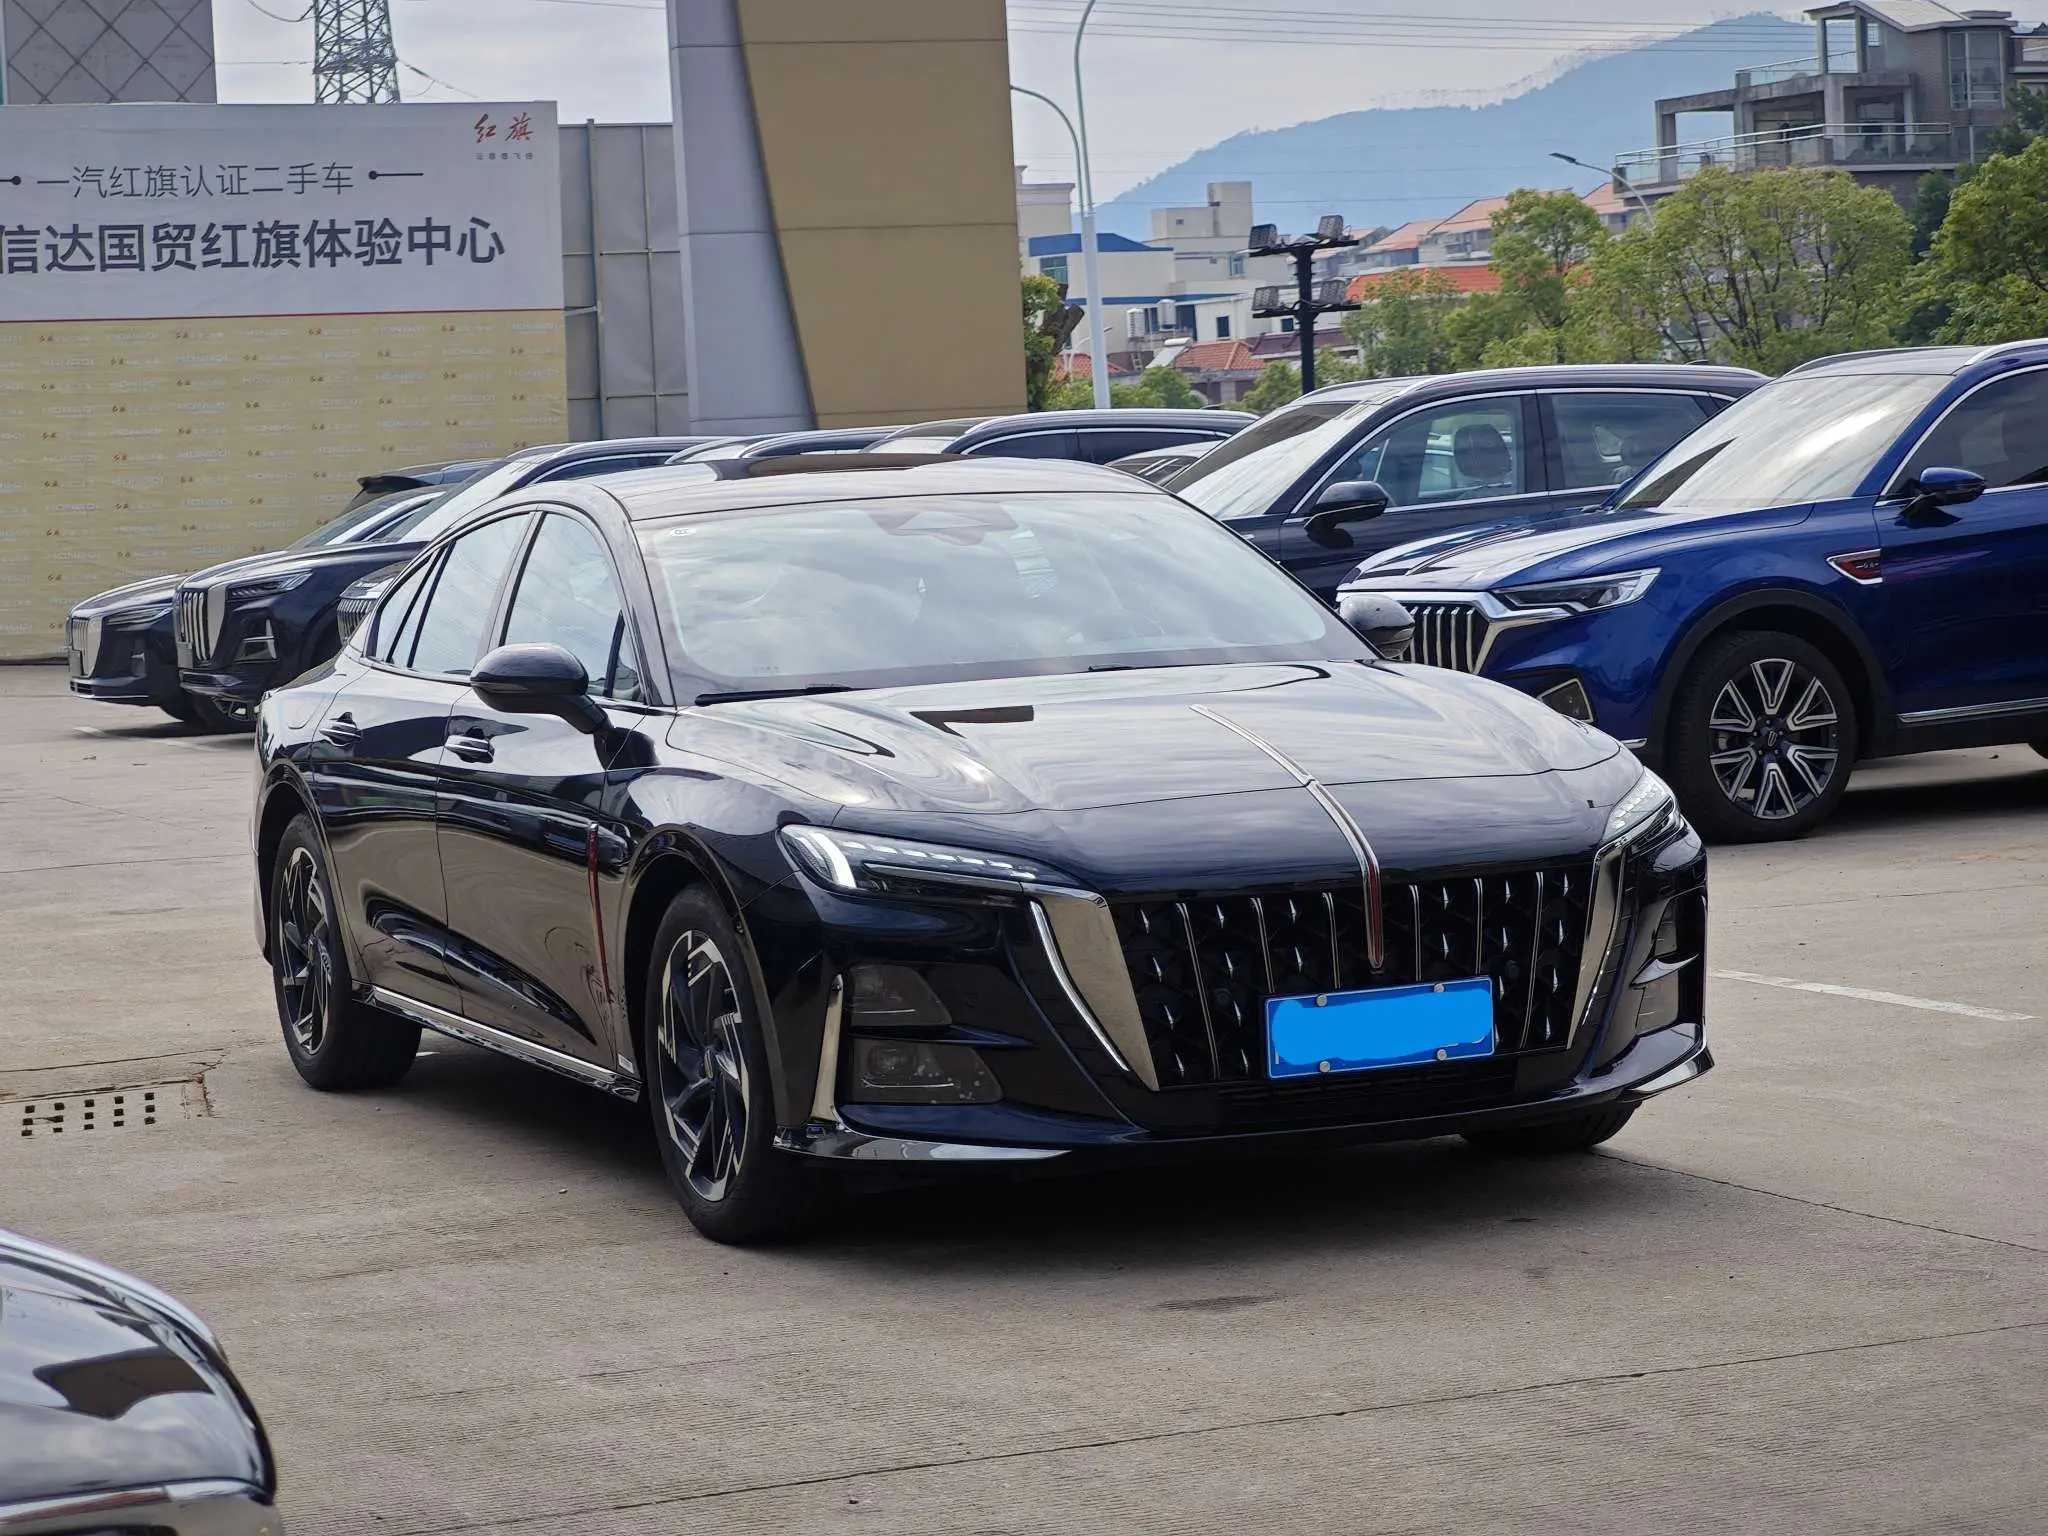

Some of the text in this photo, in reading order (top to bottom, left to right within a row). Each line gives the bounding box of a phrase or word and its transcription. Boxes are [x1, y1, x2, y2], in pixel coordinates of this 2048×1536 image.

[474, 112, 534, 143] 红旗
[36, 162, 354, 198] 一汽红旗认证二手车
[0, 217, 506, 274] 信达国贸红旗体验中心
